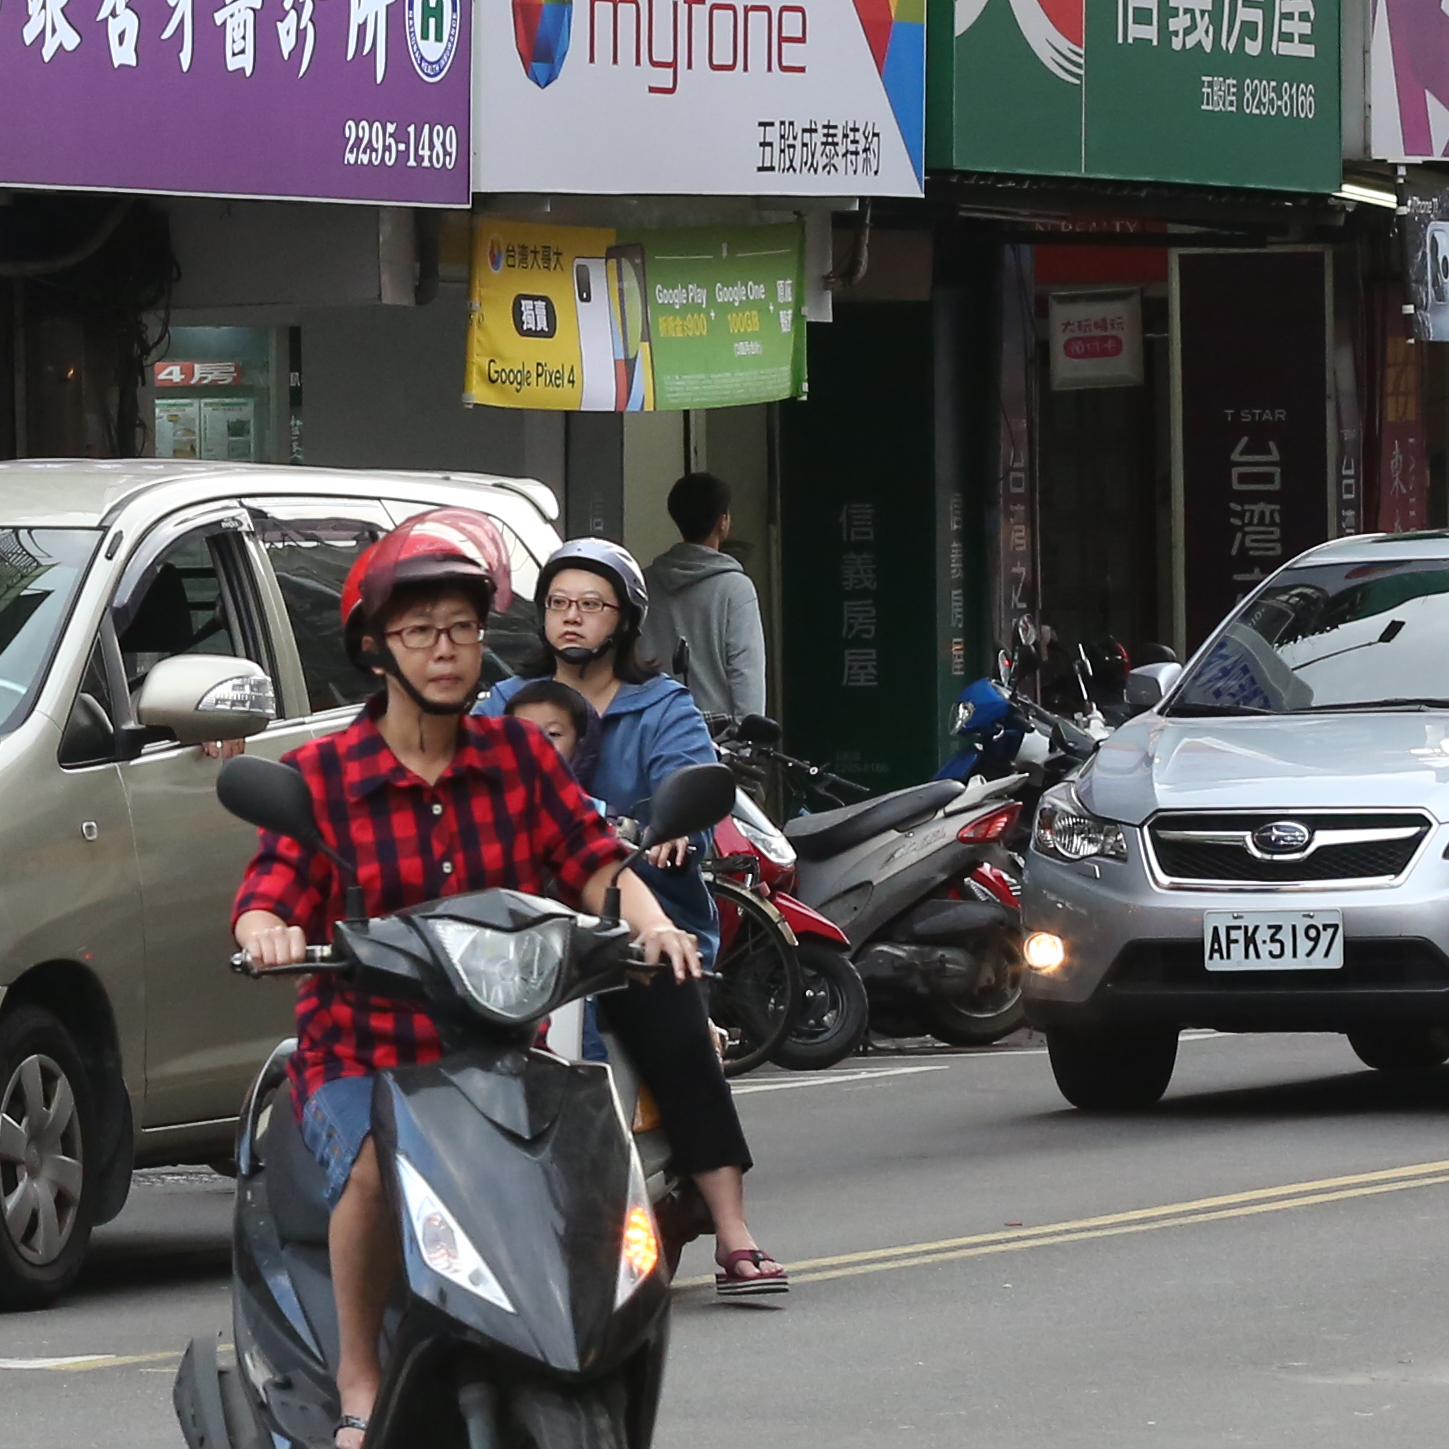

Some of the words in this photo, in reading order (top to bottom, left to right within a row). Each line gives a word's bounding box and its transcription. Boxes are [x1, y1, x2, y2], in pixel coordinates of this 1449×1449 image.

[1199, 74, 1239, 114] 五股店
[1242, 76, 1316, 121] 8295-8166
[342, 118, 458, 171] 2295-1489
[755, 119, 882, 179] 五股成泰特約
[655, 282, 688, 310] Google
[687, 283, 708, 309] Play
[715, 280, 747, 307] Google
[747, 280, 766, 301] One
[157, 363, 238, 385] 4房
[487, 358, 533, 393] Google
[535, 361, 565, 389] Pixel
[566, 364, 576, 389] 4
[1241, 408, 1287, 422] STAR
[838, 502, 879, 688] 信義房屋
